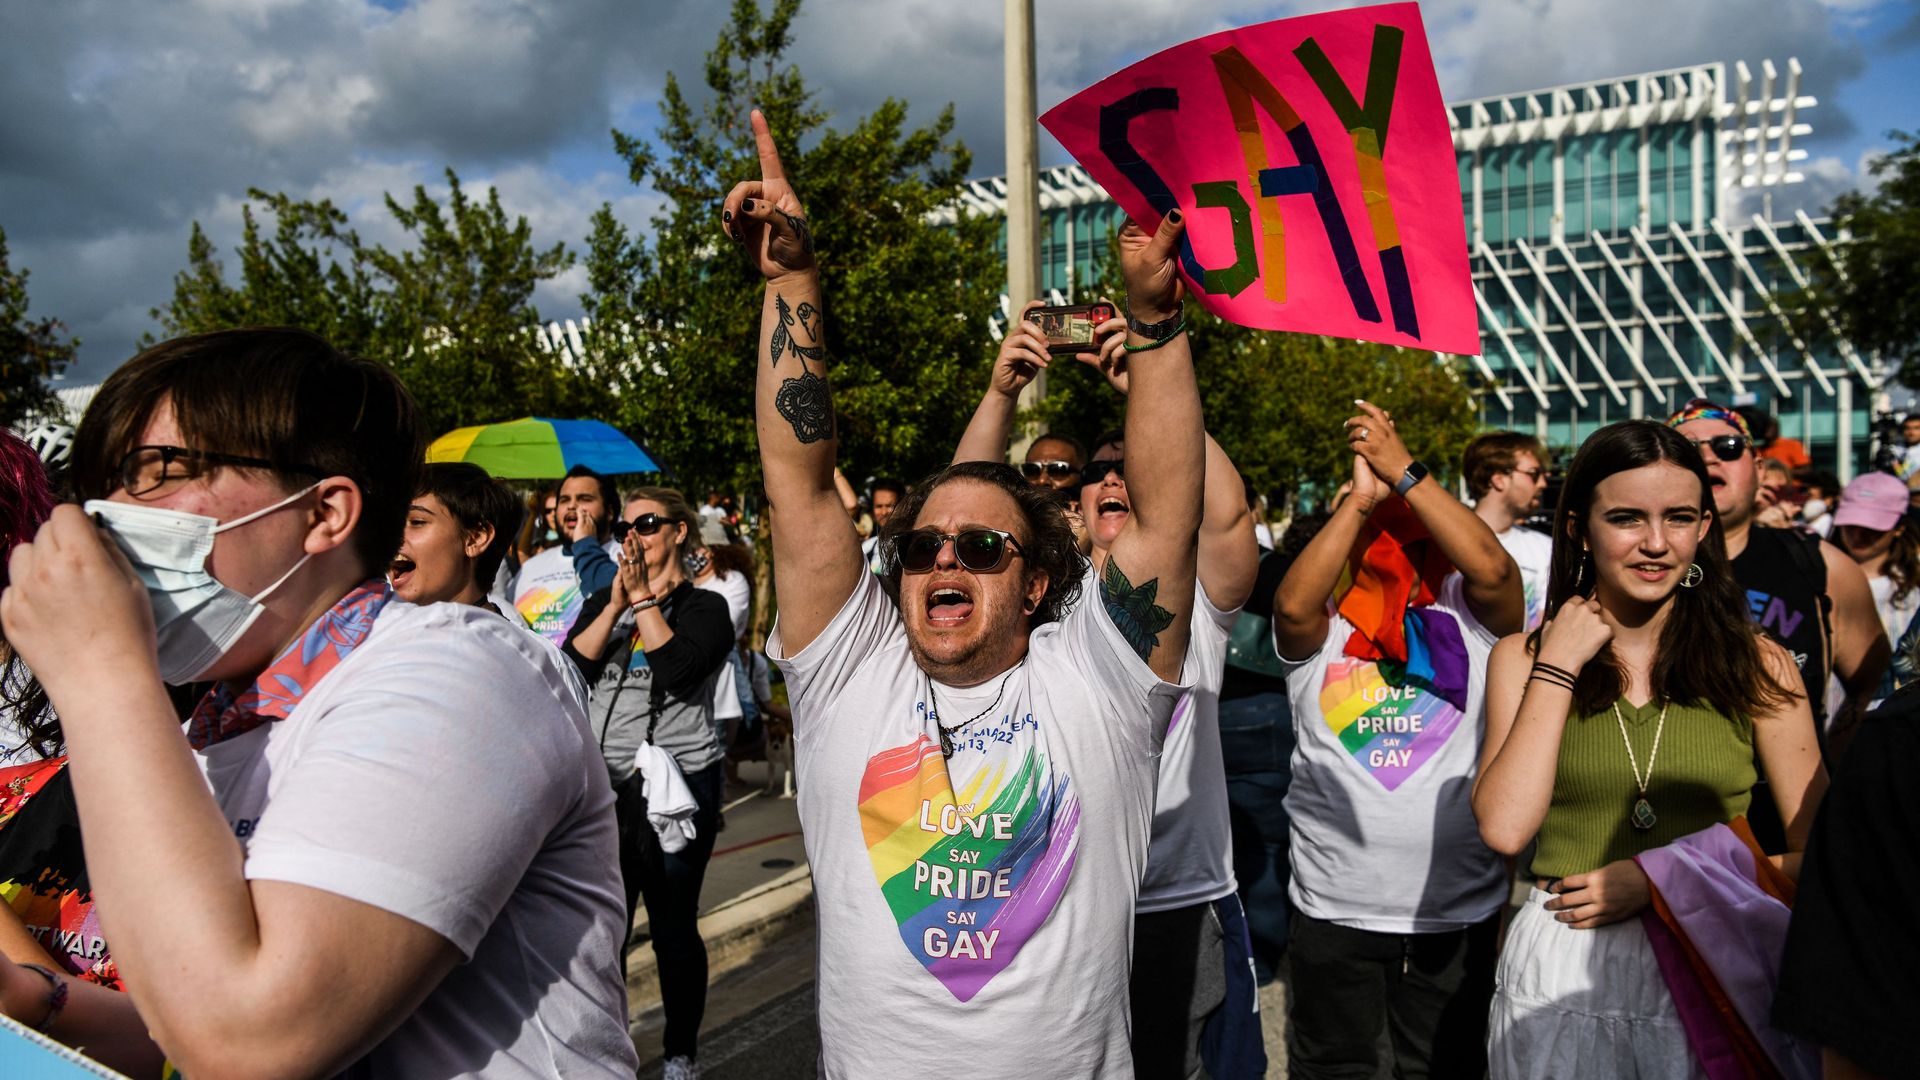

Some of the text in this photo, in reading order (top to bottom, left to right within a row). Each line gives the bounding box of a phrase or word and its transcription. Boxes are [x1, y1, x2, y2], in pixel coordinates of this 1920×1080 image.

[1100, 23, 1421, 341] GAY
[532, 601, 563, 613] LOVE
[1746, 589, 1804, 638] EN
[532, 620, 565, 631] PRIDE
[1363, 685, 1416, 702] LOVE
[1357, 714, 1423, 733] PRIDE
[1383, 739, 1400, 747] SAY
[1369, 749, 1413, 767] GAY
[957, 803, 976, 814] AY
[919, 799, 1013, 840] LOVE
[949, 849, 980, 864] SAY
[913, 859, 1013, 900] PRIDE
[946, 911, 977, 925] SAY
[51, 928, 106, 959] WAR
[923, 928, 1000, 960] GAY
